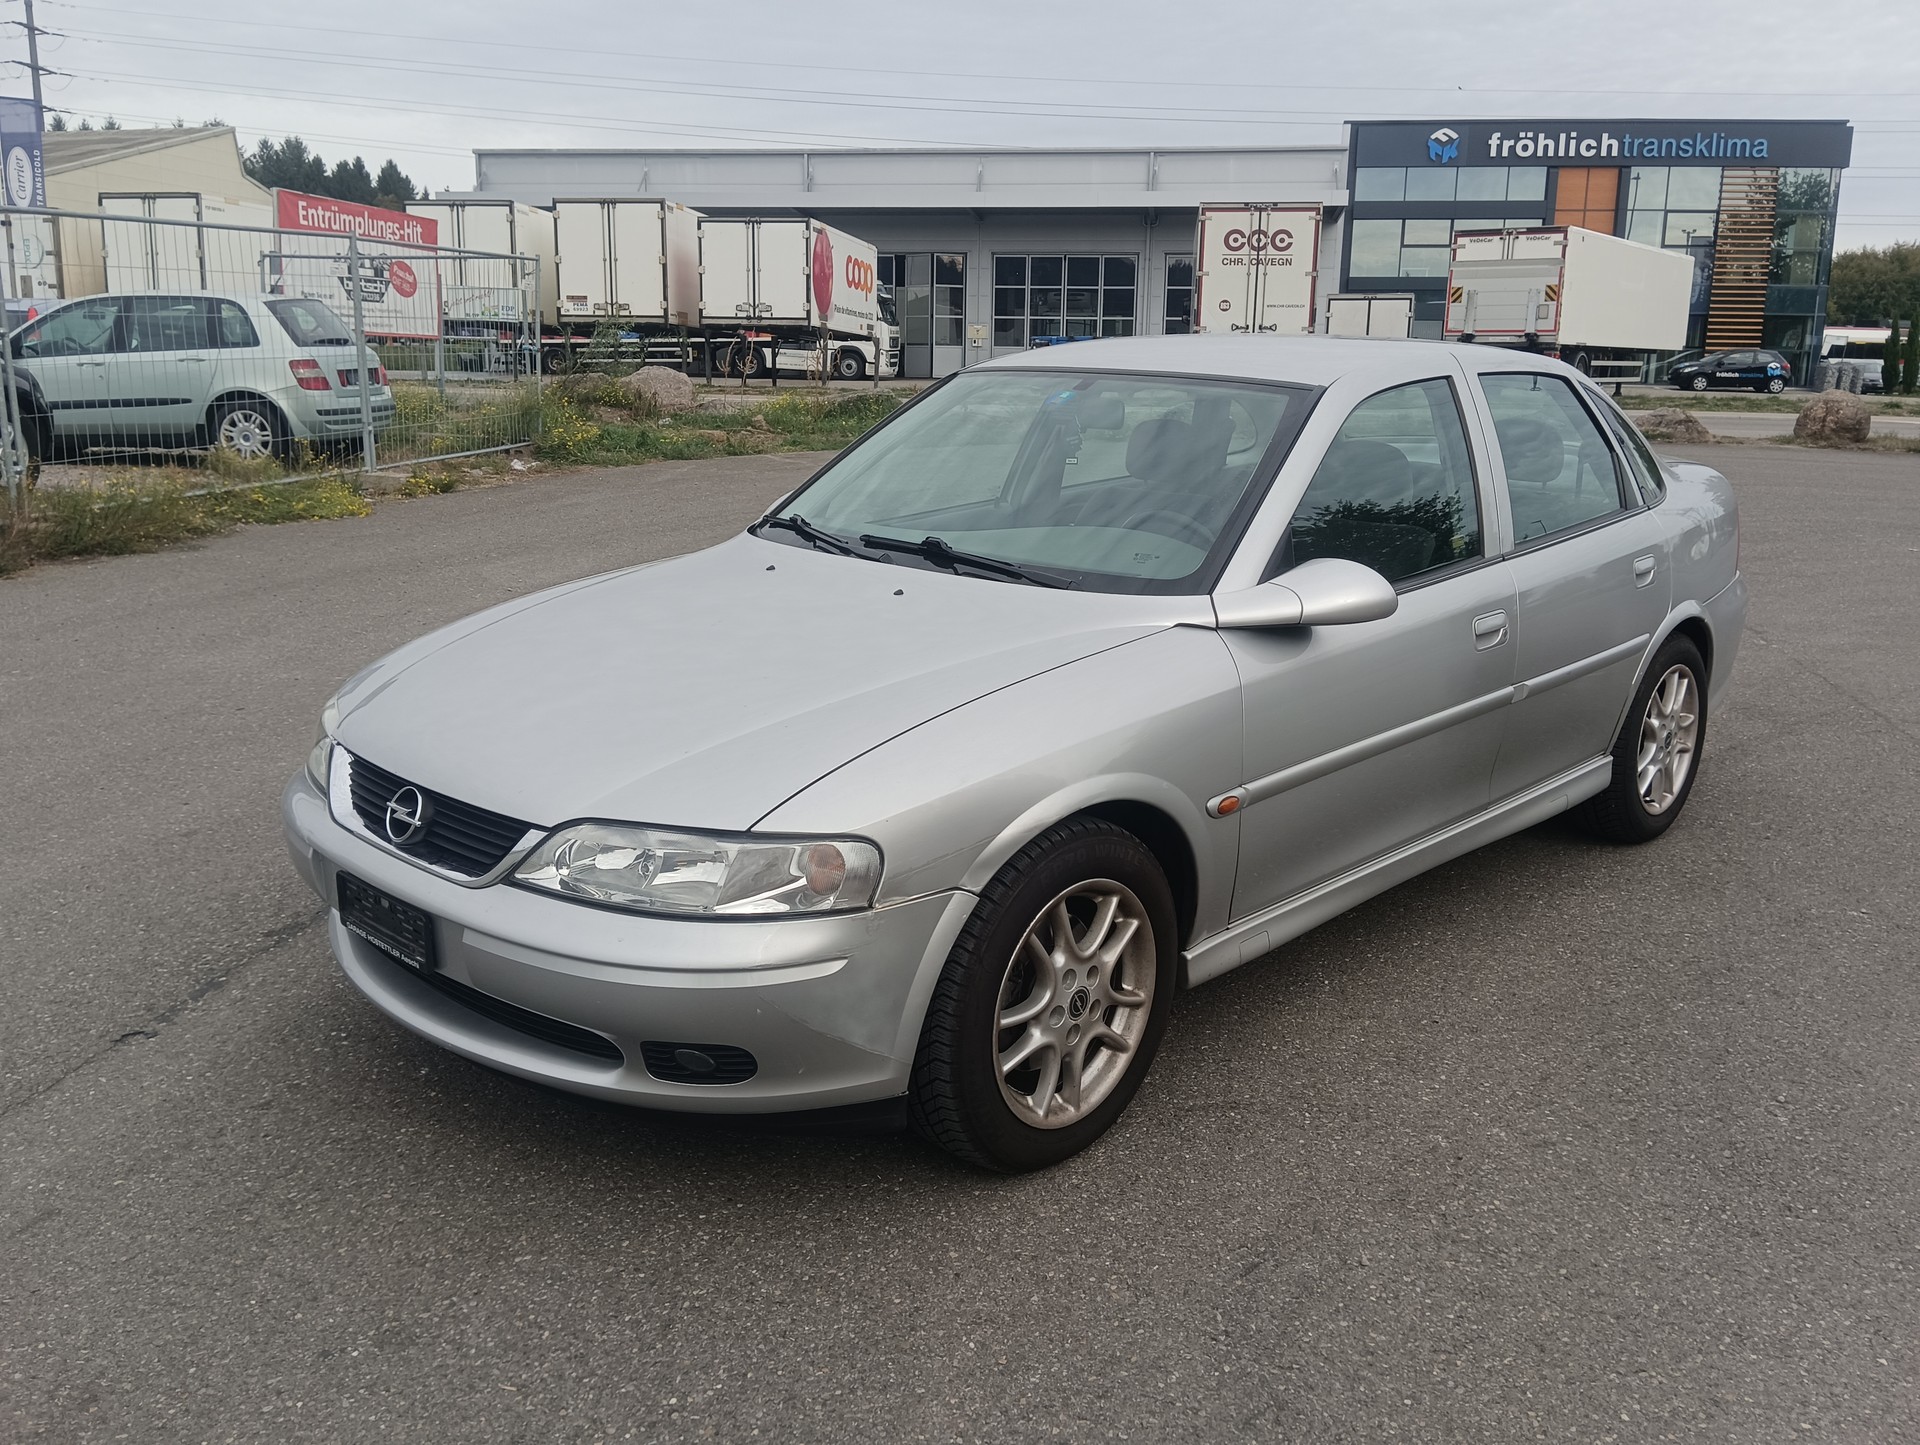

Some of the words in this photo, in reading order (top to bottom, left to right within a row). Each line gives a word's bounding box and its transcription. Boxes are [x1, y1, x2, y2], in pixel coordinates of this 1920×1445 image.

[14, 155, 27, 200] Carrier
[33, 149, 44, 206] TRANSICOLD
[298, 200, 423, 244] Entrümplungs-Hit
[1223, 229, 1294, 252] CCC
[845, 254, 873, 302] coop
[1221, 257, 1247, 266] CHR.
[1250, 257, 1293, 266] CAVEGN
